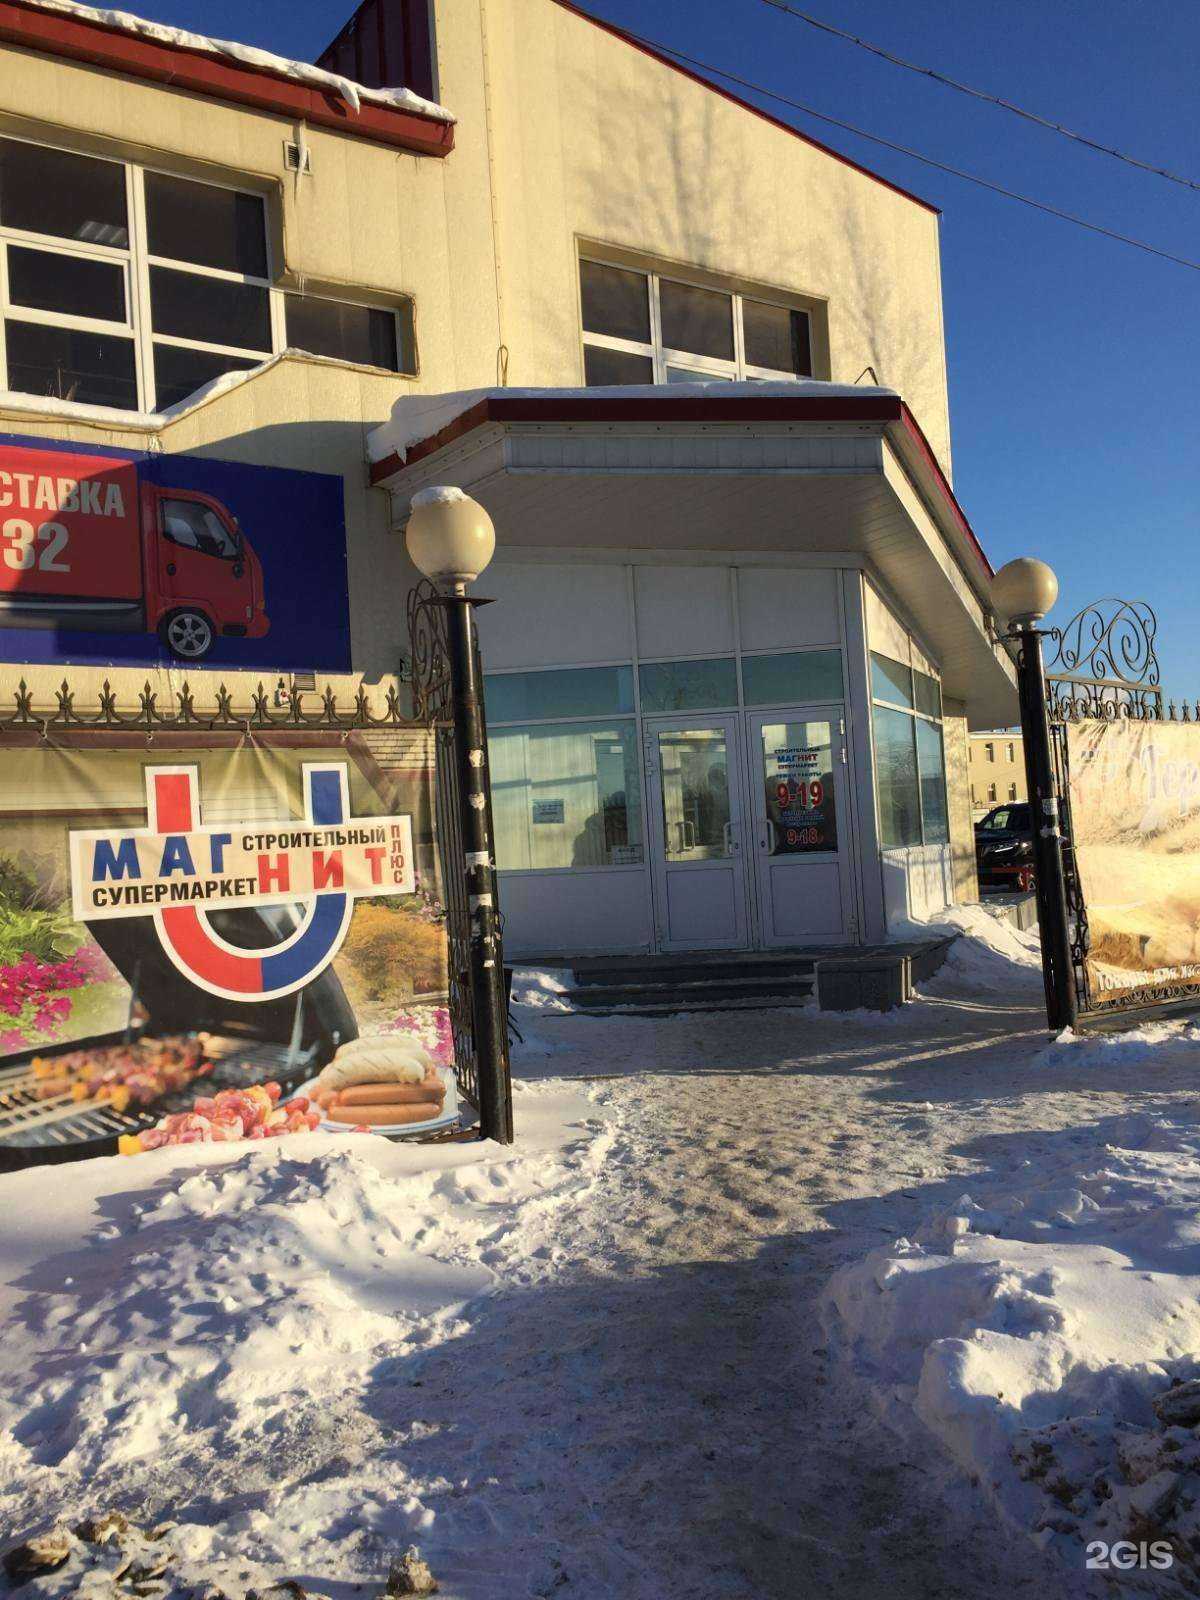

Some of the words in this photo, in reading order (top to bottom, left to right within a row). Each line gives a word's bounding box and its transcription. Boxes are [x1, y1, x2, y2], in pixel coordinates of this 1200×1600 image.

[3, 518, 71, 572] 32
[777, 754, 818, 763] МАГНИТ
[776, 781, 824, 808] 9-19
[242, 825, 387, 852] СТРОИТЕЛЬНЫЙ
[390, 825, 406, 884] ПЛЮС
[92, 877, 258, 907] СУПЕРМАРКЕТ
